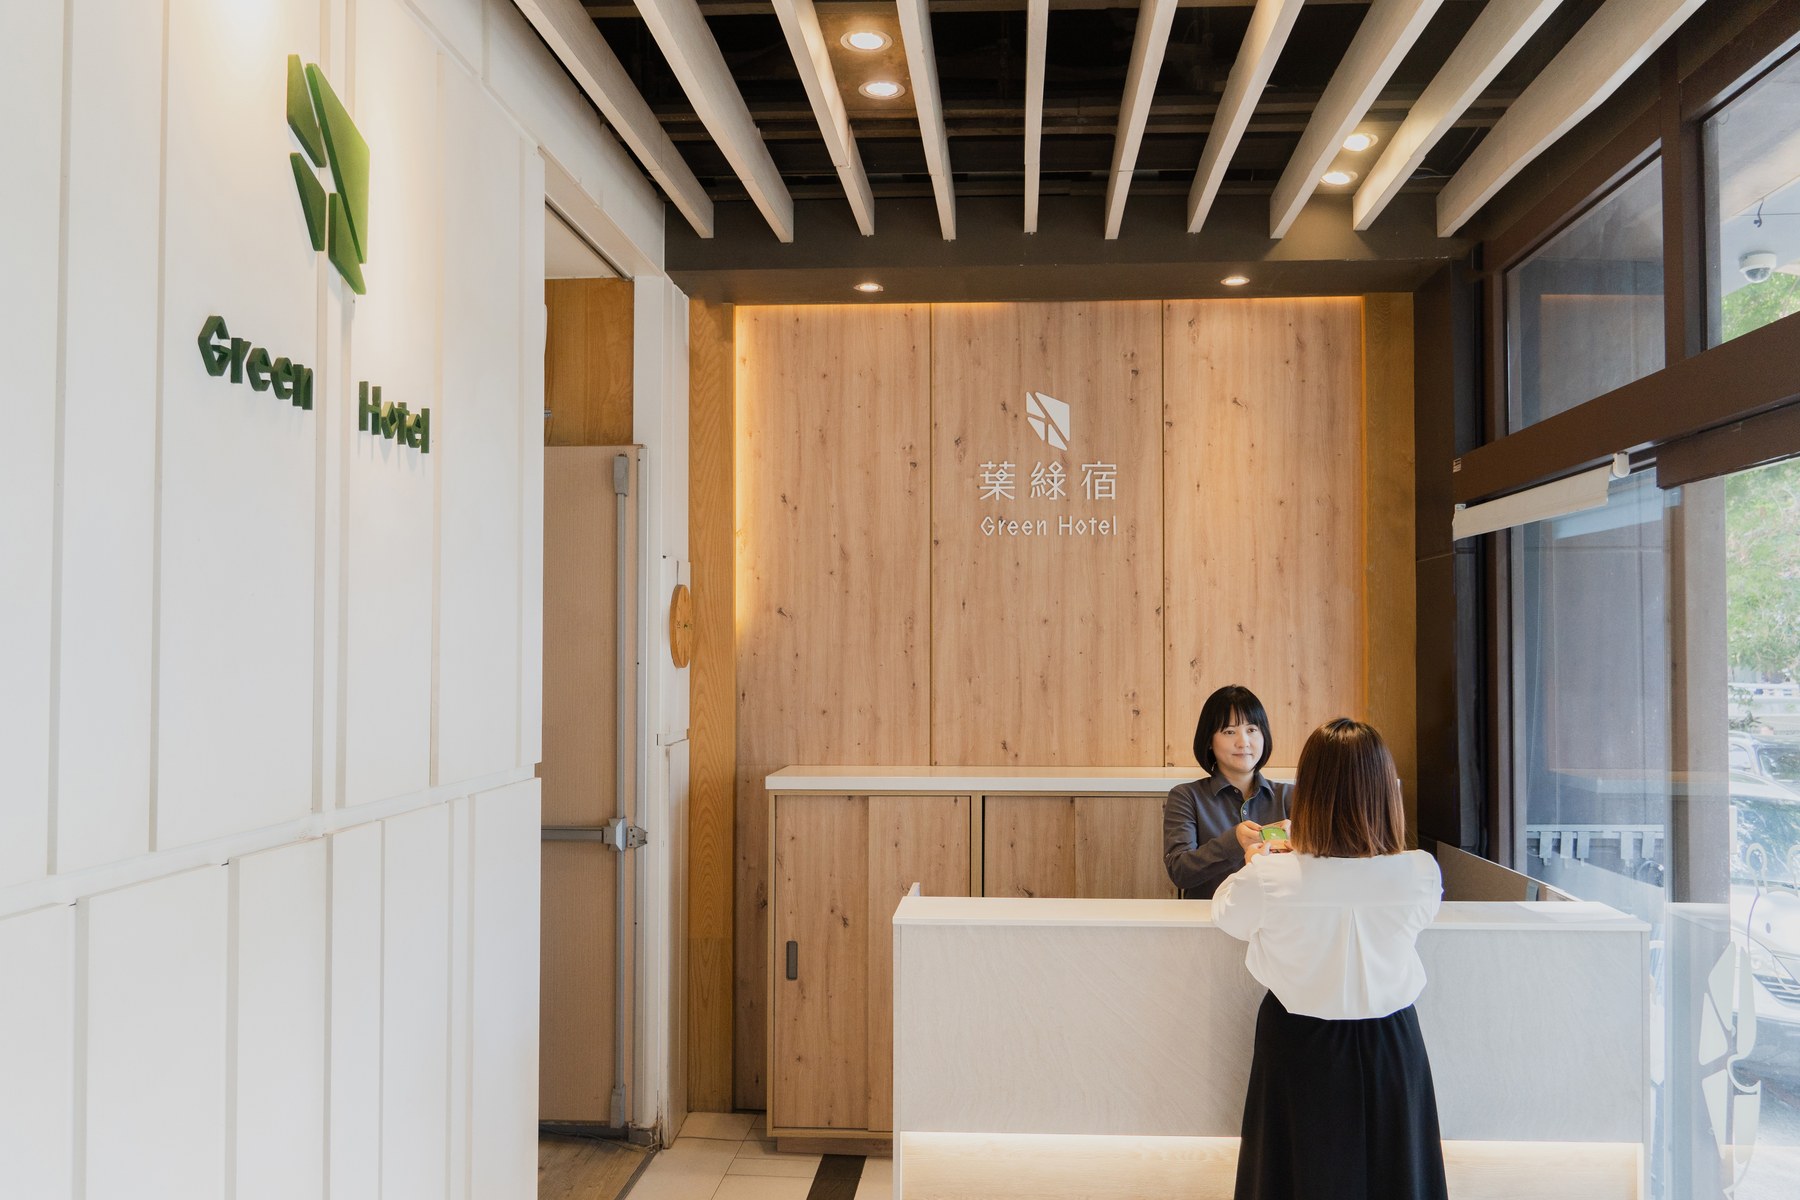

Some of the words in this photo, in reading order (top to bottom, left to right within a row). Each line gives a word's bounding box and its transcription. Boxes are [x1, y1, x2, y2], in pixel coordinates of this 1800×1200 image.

[197, 315, 313, 411] Green
[358, 380, 430, 454] Hotel
[979, 460, 1118, 501] 葉綠宿
[980, 515, 1047, 537] Green
[1058, 514, 1117, 536] Hotel
